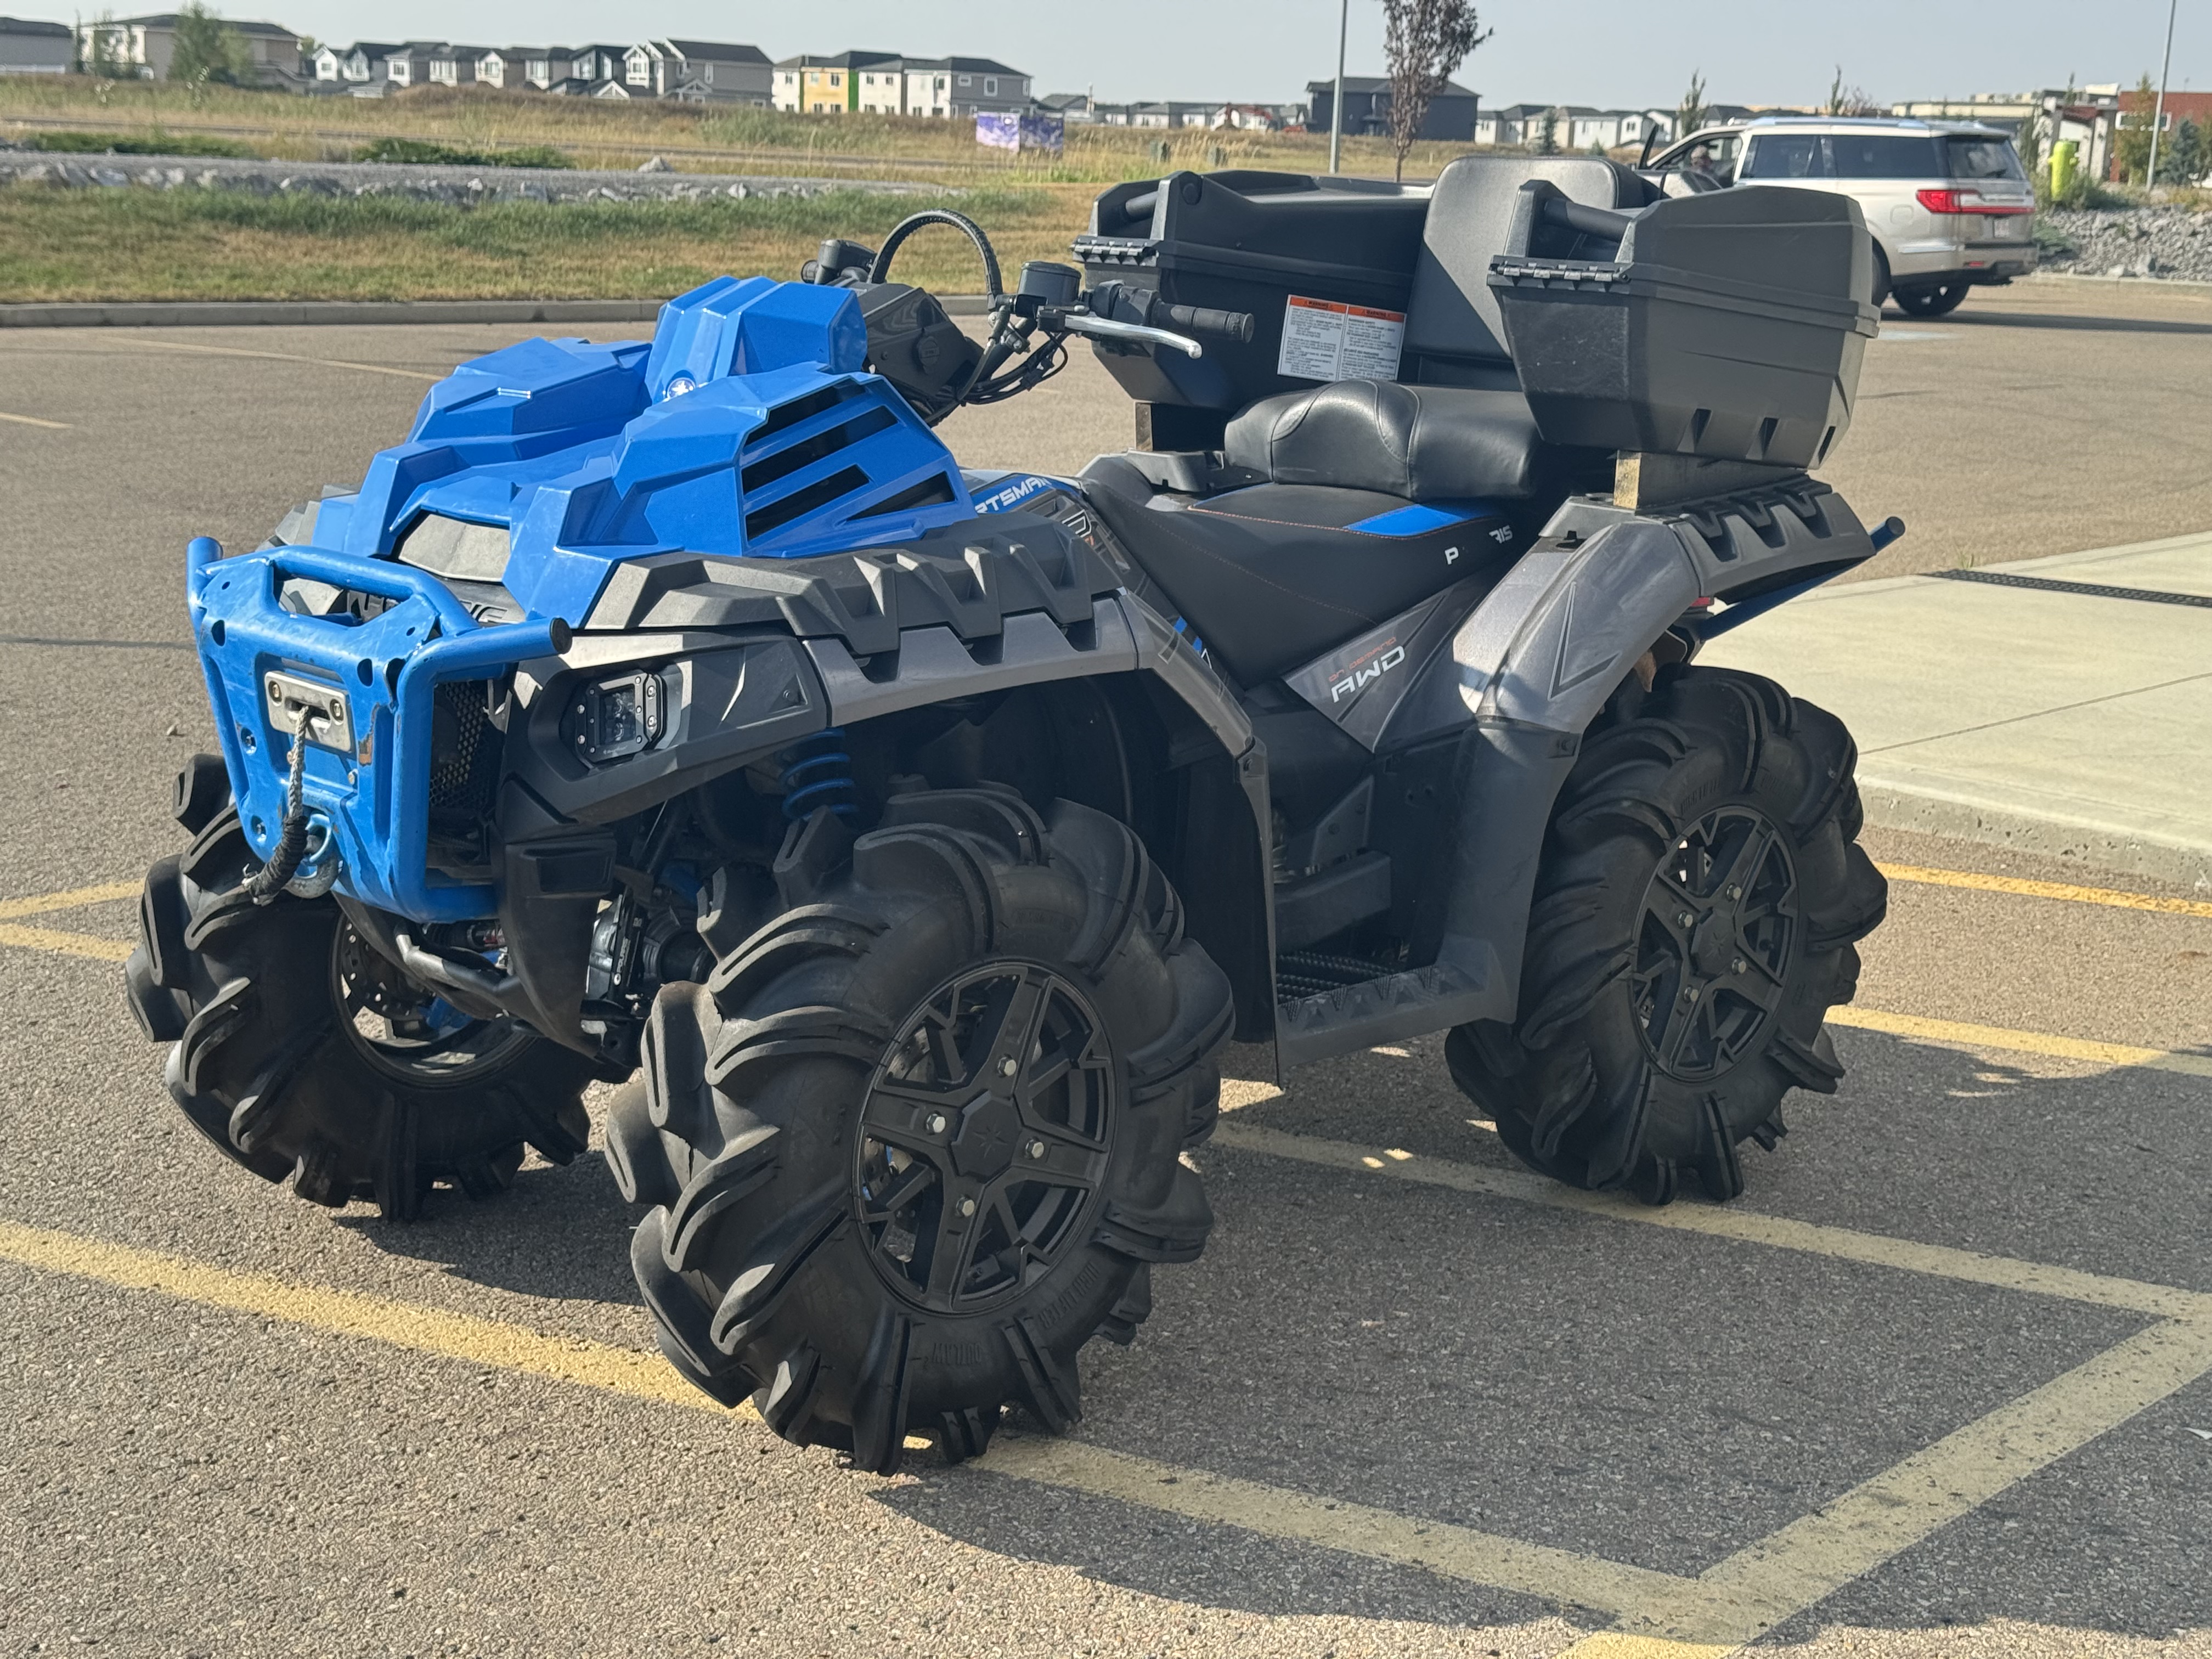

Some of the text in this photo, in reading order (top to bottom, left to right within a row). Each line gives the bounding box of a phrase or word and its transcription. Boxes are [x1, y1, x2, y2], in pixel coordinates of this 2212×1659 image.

[975, 477, 1052, 514] RTSMAN
[1331, 645, 1405, 703] AWD
[1037, 1289, 1077, 1329] LIFTER
[932, 1342, 981, 1366] OUTLAW
